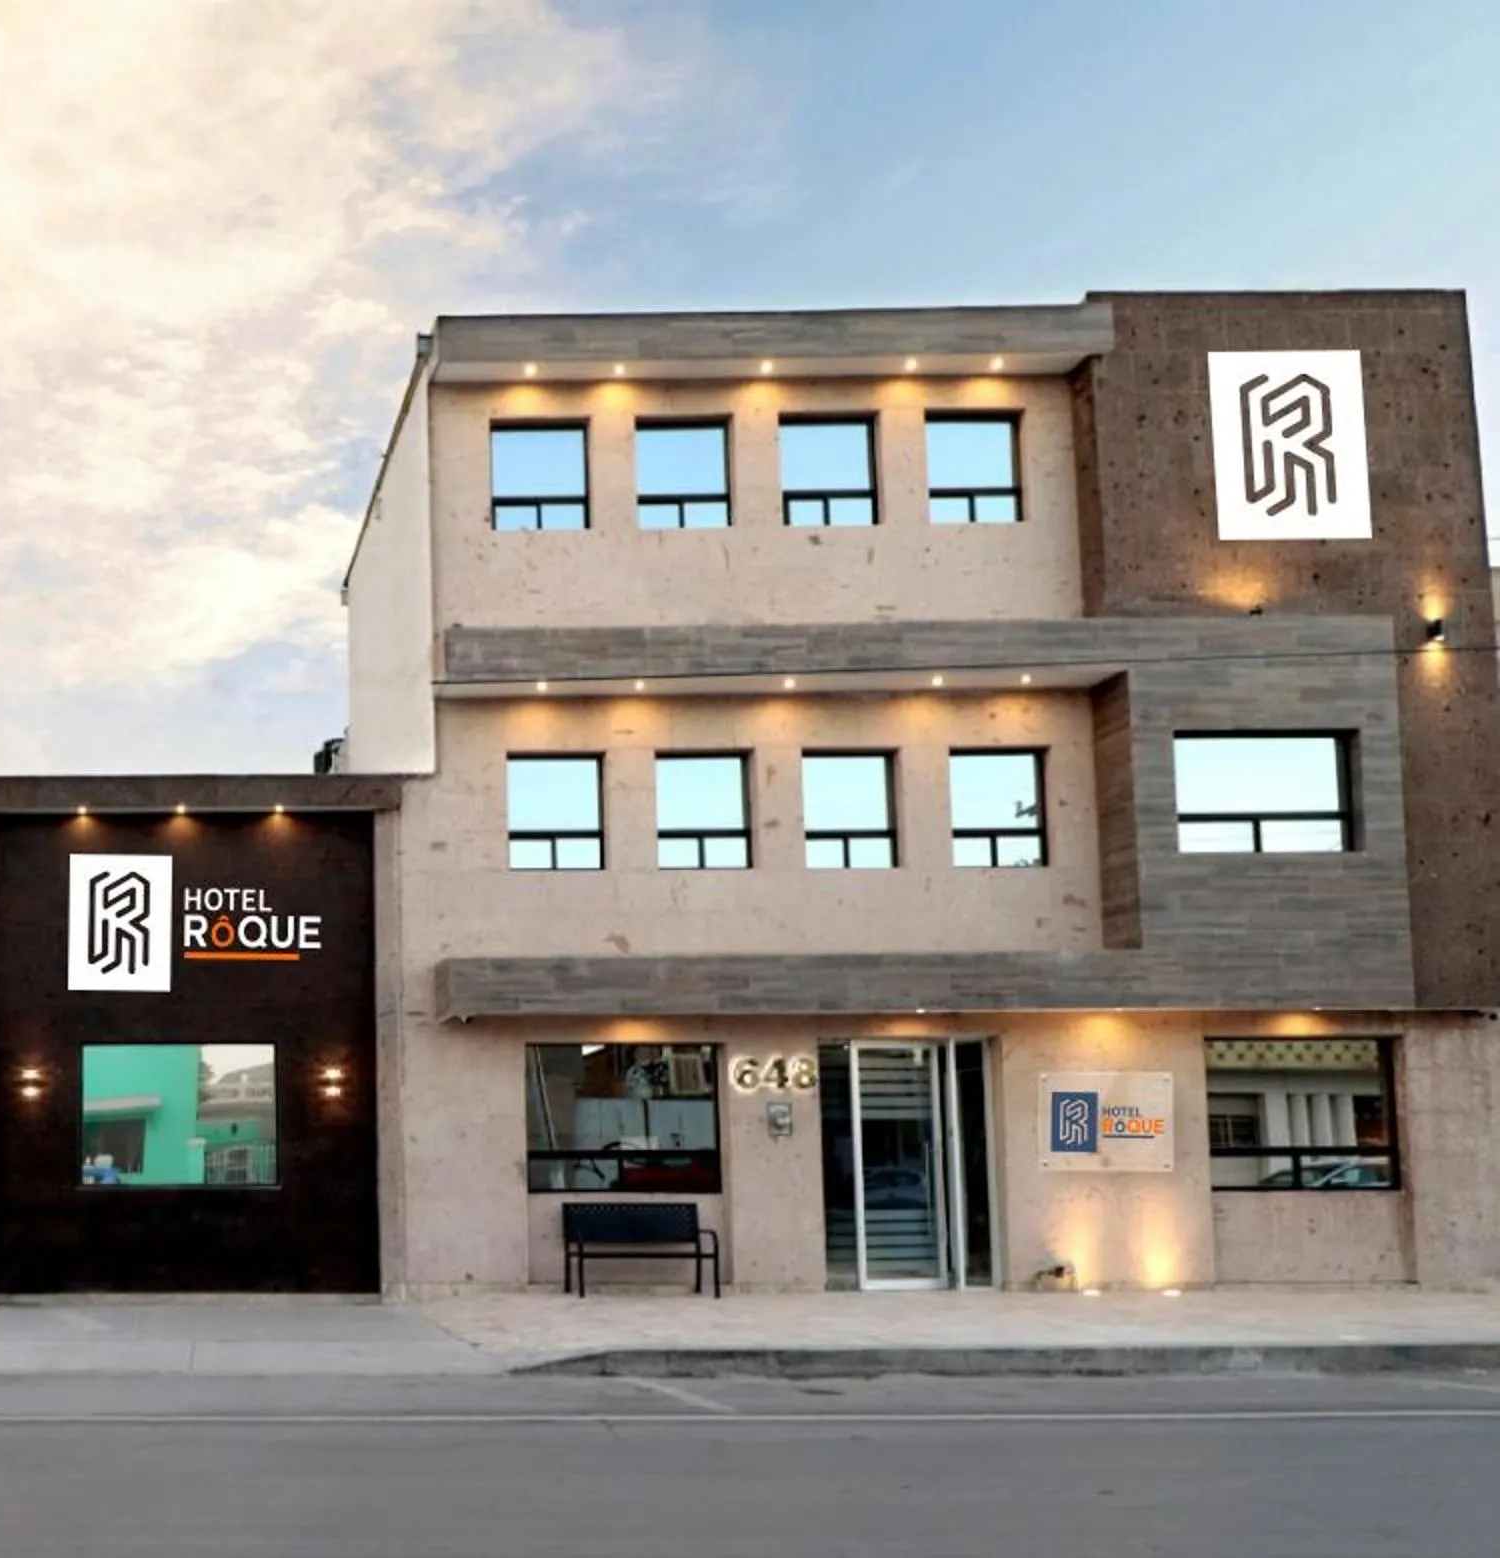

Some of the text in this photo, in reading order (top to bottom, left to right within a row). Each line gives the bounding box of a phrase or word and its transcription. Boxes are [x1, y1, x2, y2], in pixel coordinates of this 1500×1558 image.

[184, 888, 273, 912] HOTEL
[731, 1058, 818, 1090] 648
[1103, 1106, 1141, 1117] HOTEL
